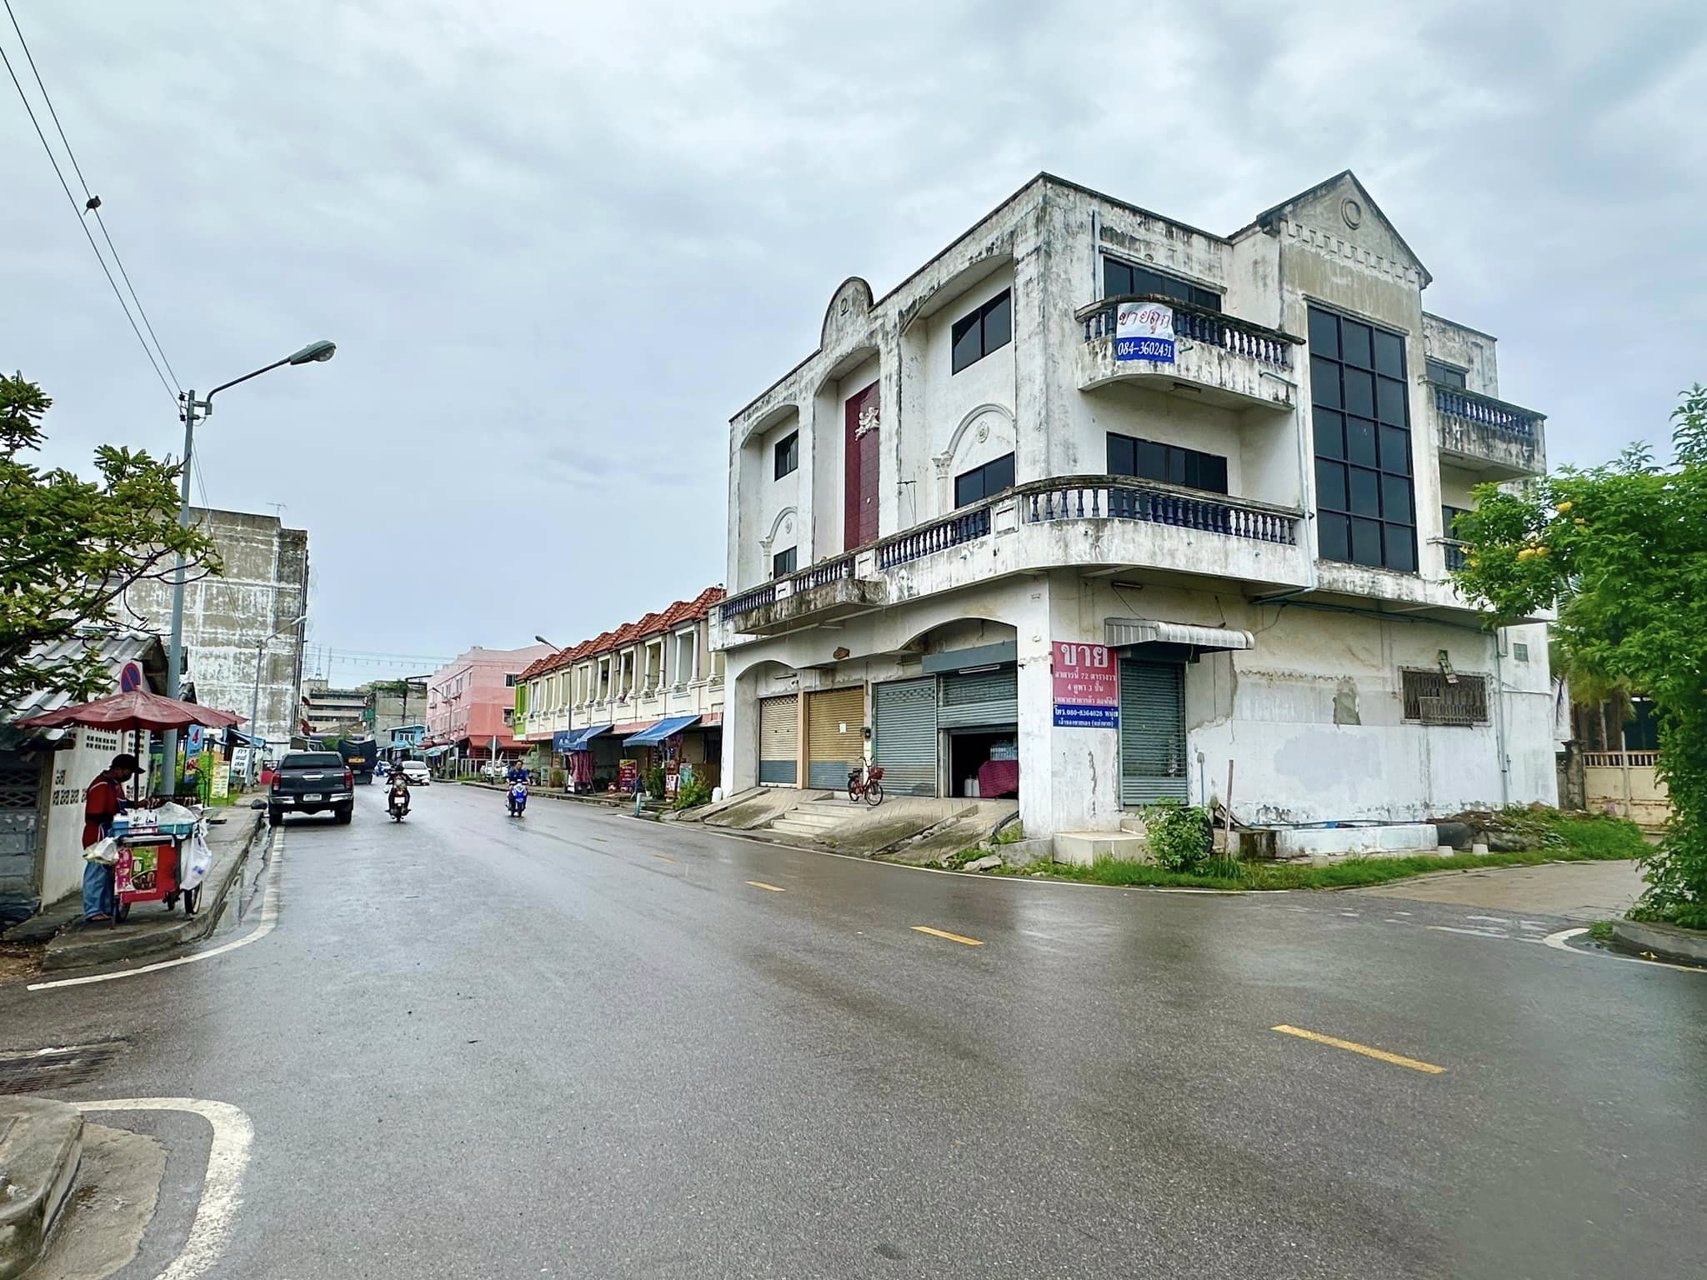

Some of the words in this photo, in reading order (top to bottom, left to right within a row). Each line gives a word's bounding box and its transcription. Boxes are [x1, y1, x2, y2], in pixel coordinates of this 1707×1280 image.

[1119, 311, 1170, 334] ขายถูก
[1118, 342, 1172, 358] 084-3602431
[1061, 644, 1108, 668] ขาย
